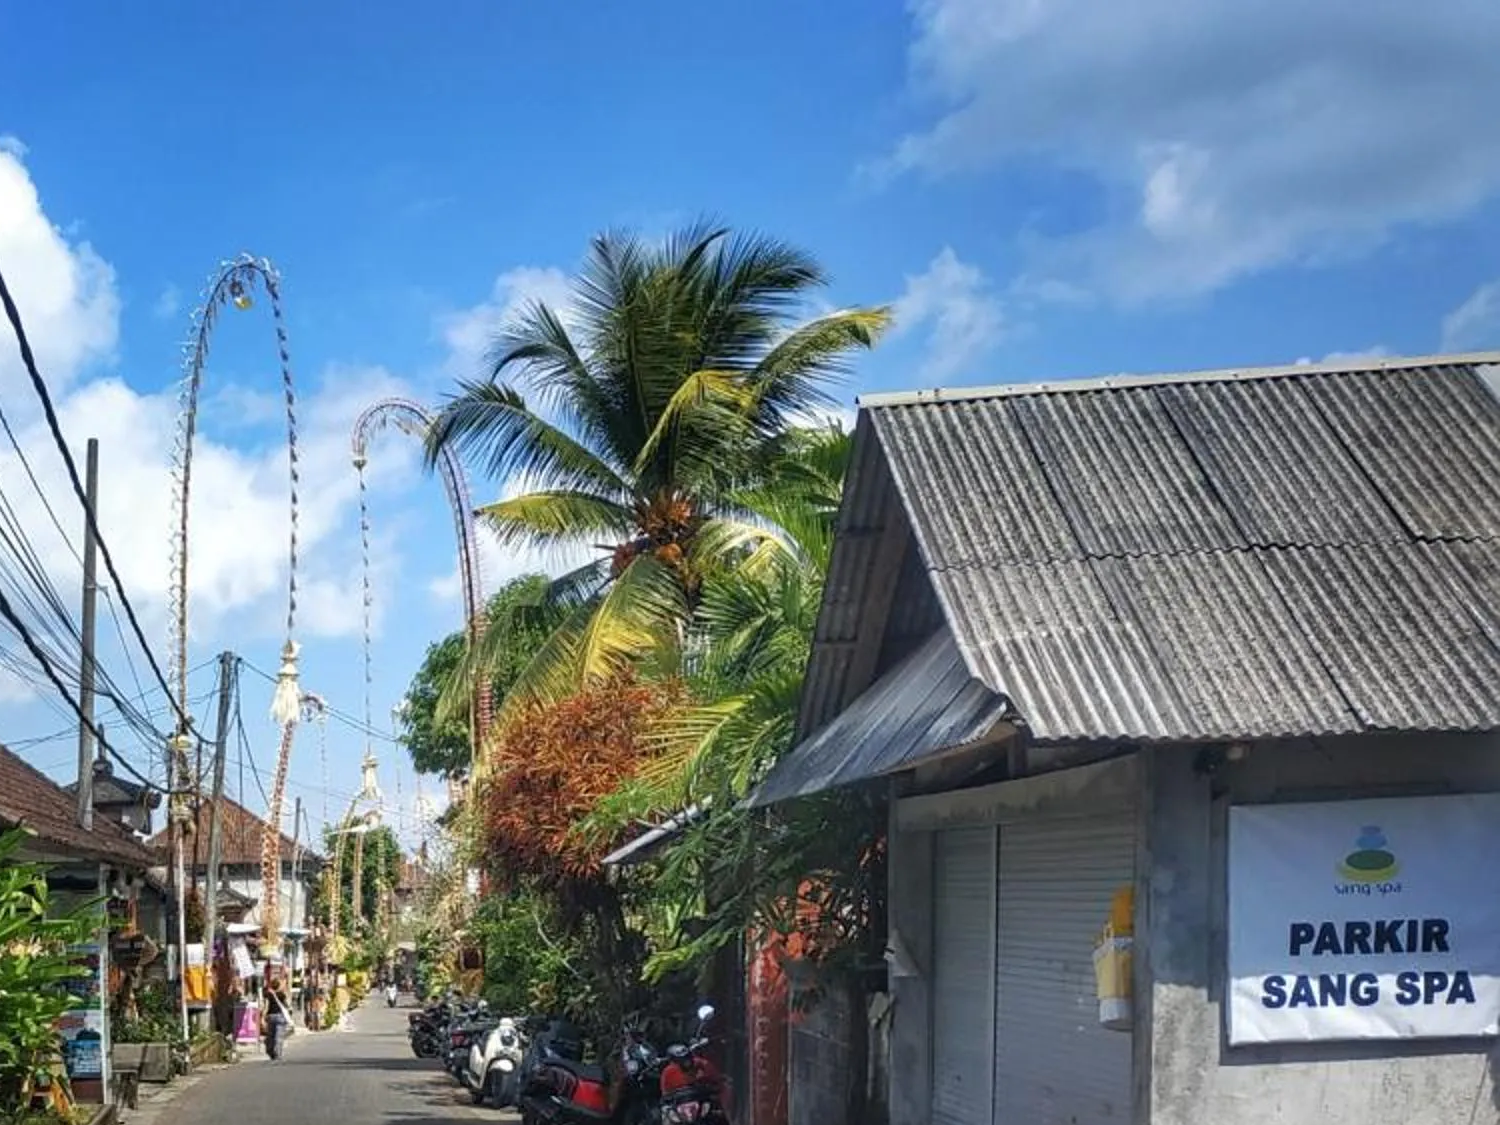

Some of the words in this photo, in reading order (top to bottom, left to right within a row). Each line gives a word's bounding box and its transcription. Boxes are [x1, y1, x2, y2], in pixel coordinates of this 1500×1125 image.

[1288, 919, 1450, 956] PARKIR
[1261, 972, 1380, 1009] SANG
[1395, 970, 1477, 1006] SPA
